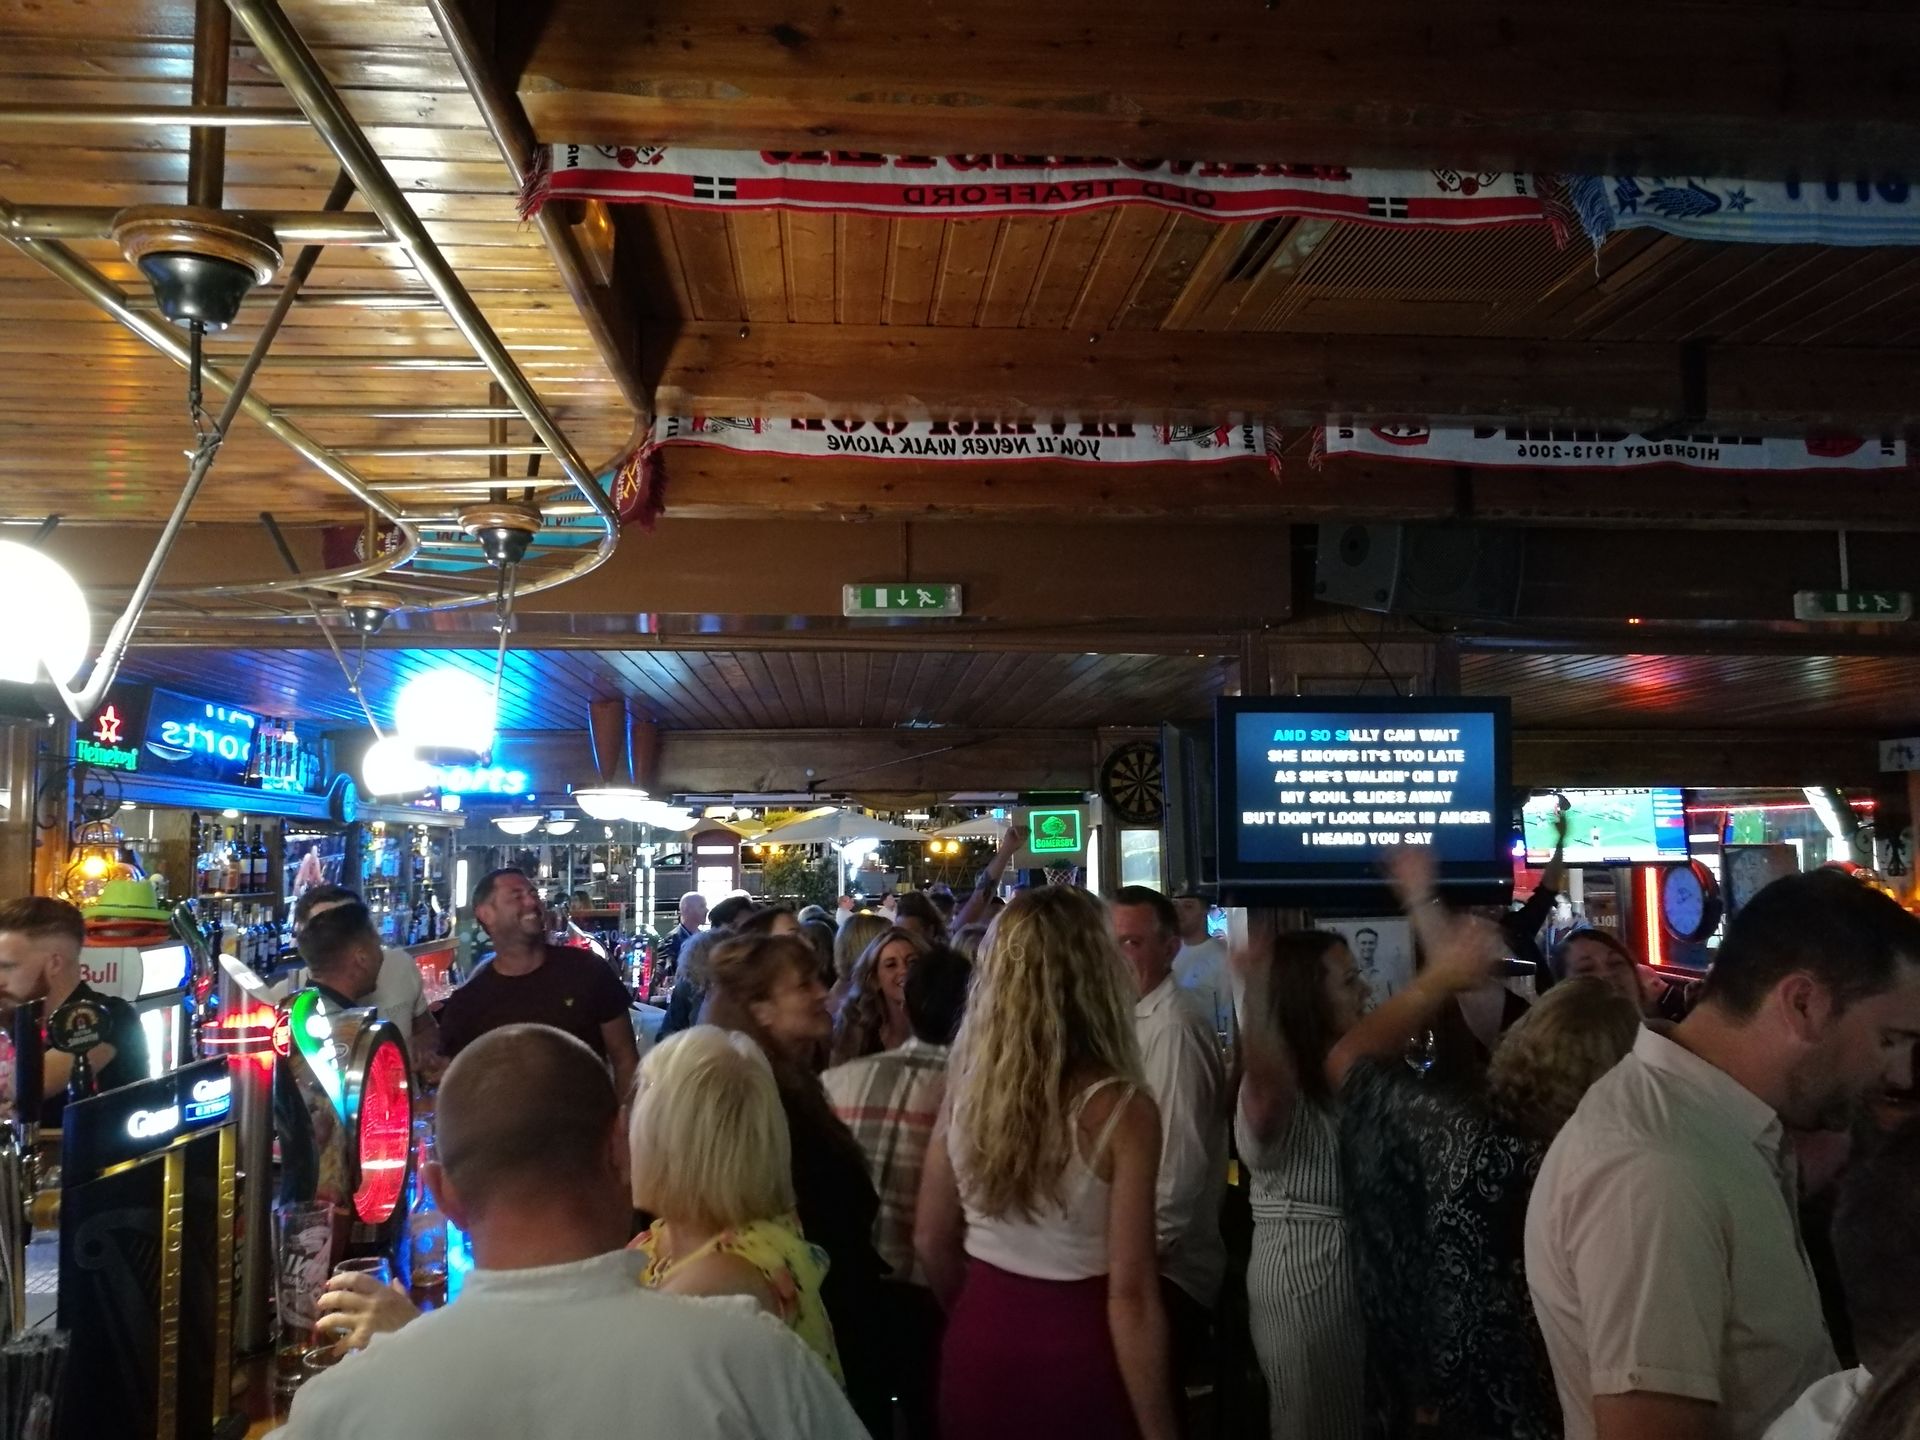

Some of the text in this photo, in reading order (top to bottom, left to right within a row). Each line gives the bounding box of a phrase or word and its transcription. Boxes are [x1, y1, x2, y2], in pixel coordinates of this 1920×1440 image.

[1273, 729, 1460, 742] AND SO SALLY CAN WAIT
[1267, 749, 1465, 763] SHE KNOWS IT'S TOO LATE
[1274, 770, 1458, 783] AS SHE'S WALKIN' ON BY
[1280, 791, 1453, 804] MY SOUL SLIDES AWAY
[1242, 811, 1491, 824] BUT DON'T LOOK BACK IN ANGER
[1035, 837, 1075, 848] SOMERSBY
[1302, 832, 1433, 845] I HEARD YOU SAY
